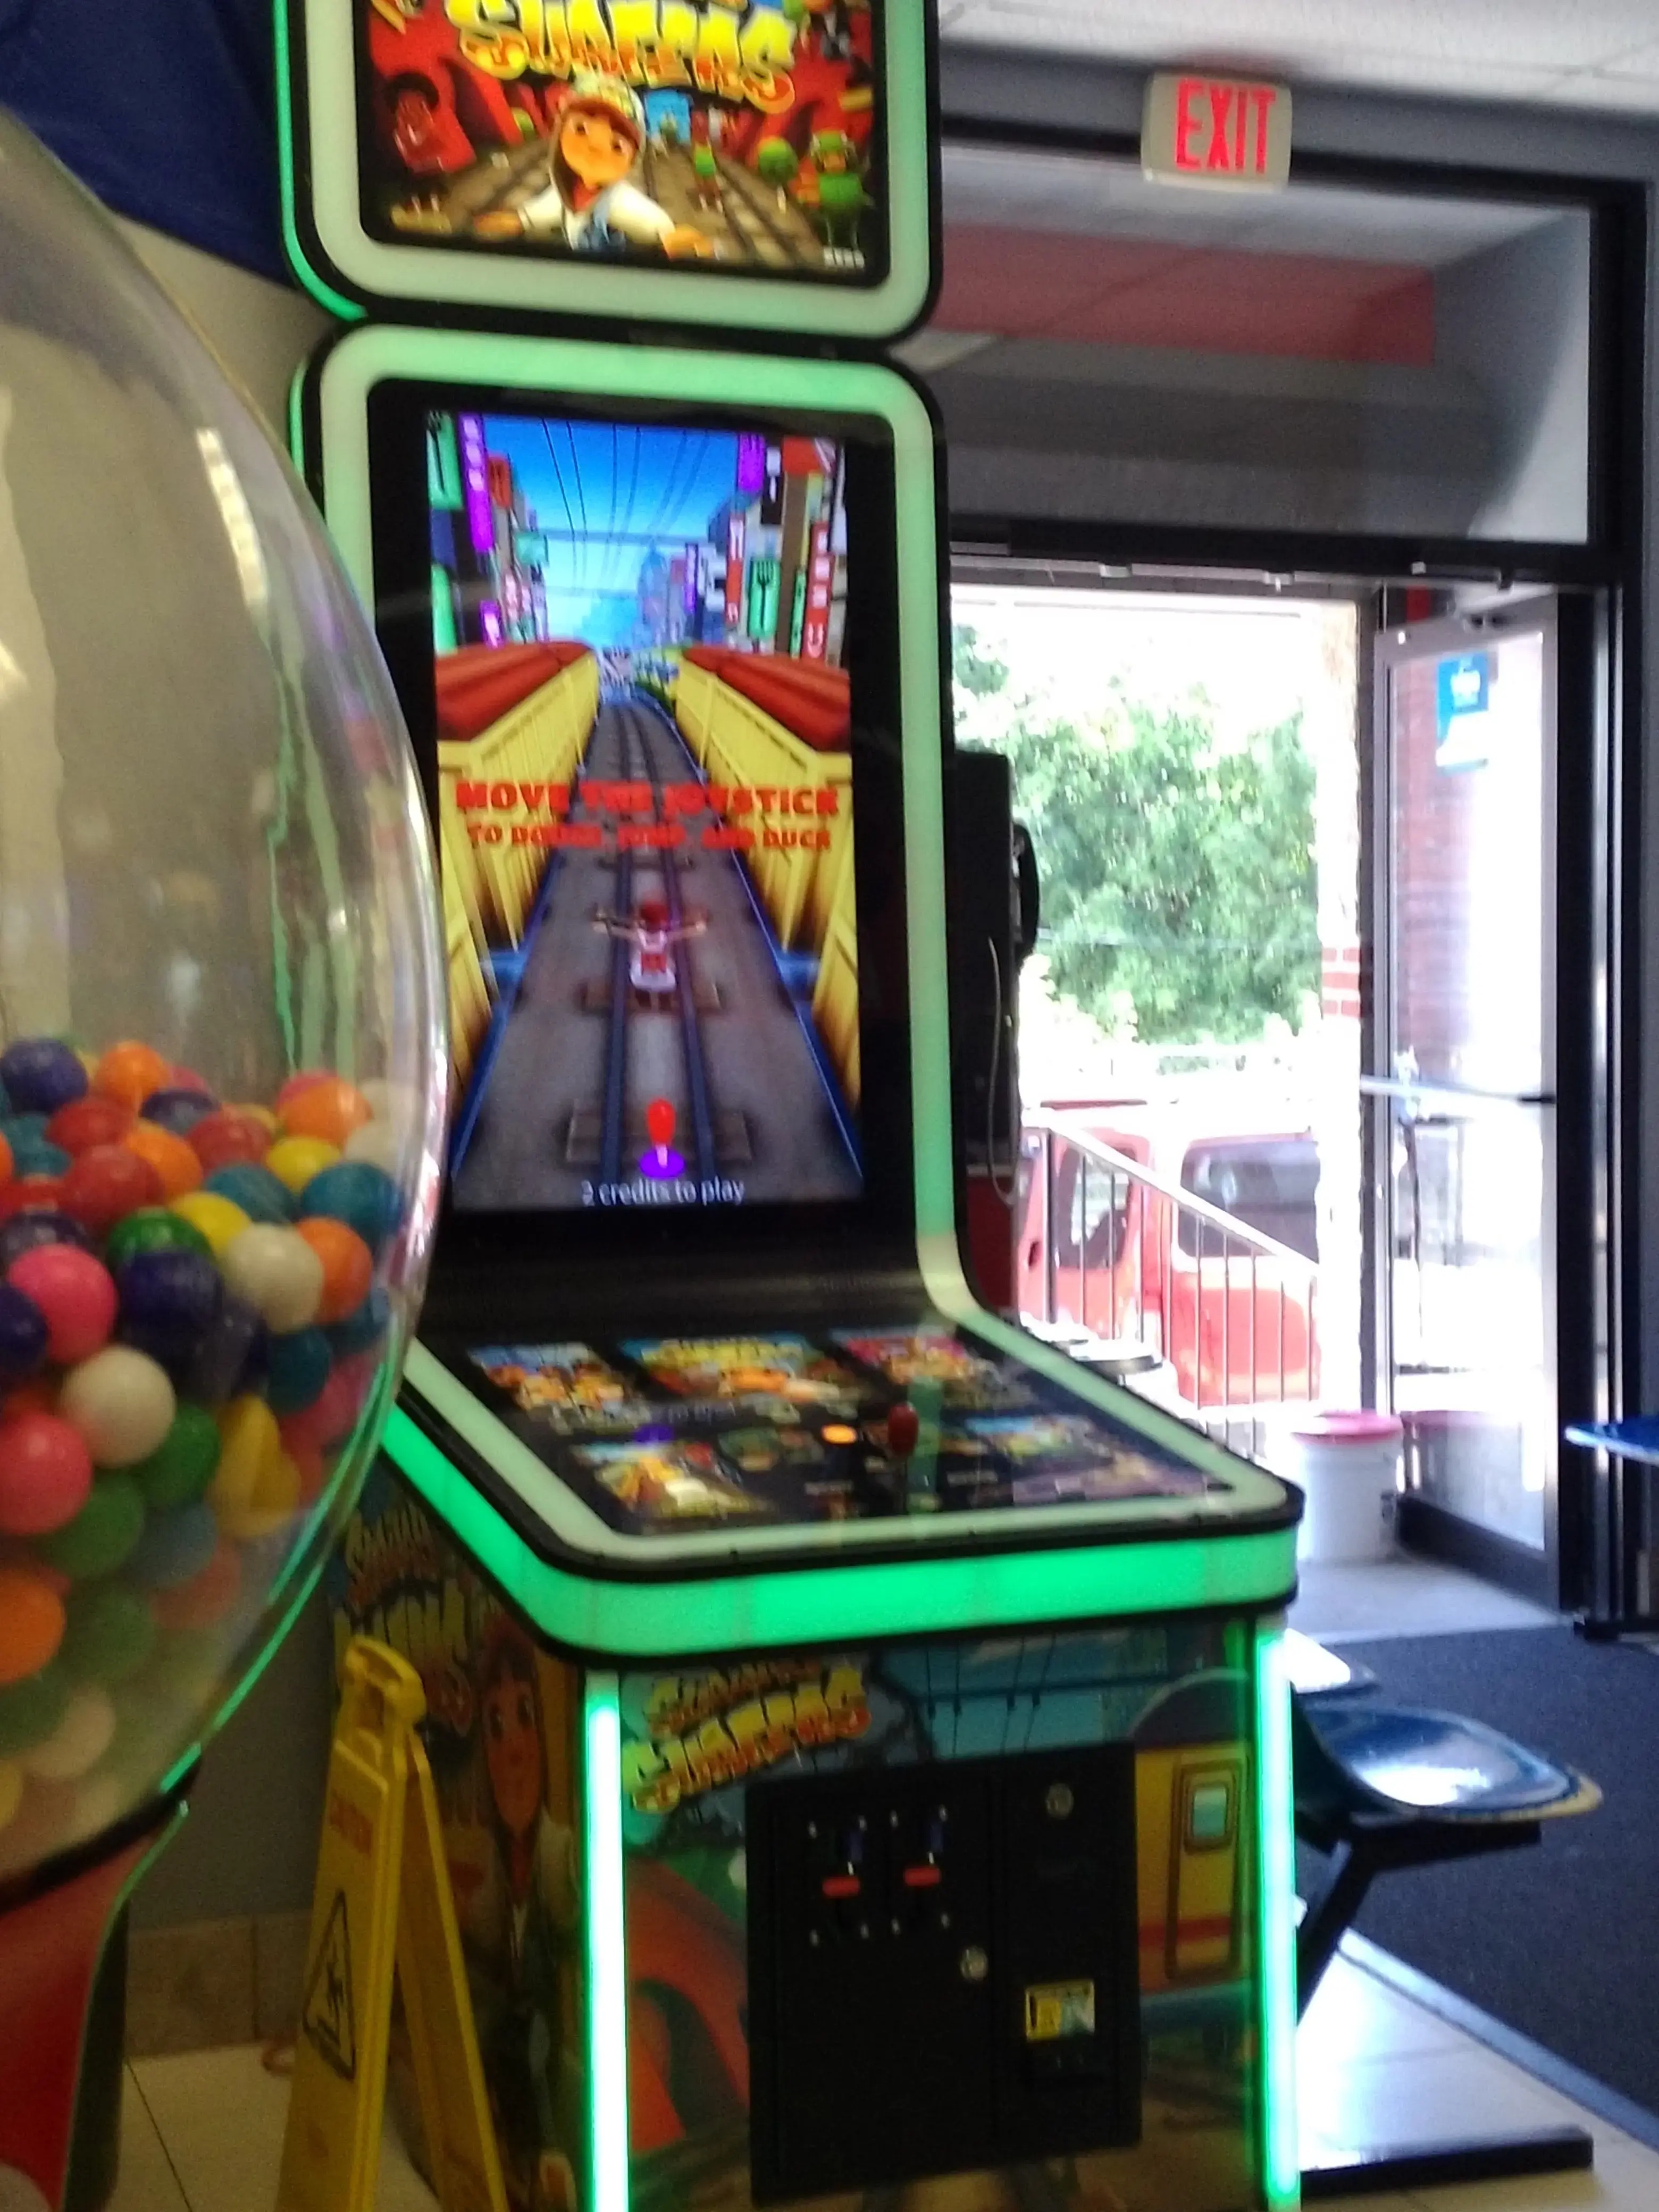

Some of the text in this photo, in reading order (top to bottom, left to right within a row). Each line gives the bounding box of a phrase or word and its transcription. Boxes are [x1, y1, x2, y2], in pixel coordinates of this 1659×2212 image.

[1175, 77, 1278, 175] EXIT
[456, 781, 570, 814] MOVE
[663, 783, 839, 817] JOYSTICK
[466, 823, 502, 844] TO
[763, 829, 831, 850] DUCK
[581, 1175, 745, 1206] 2 credits to play
